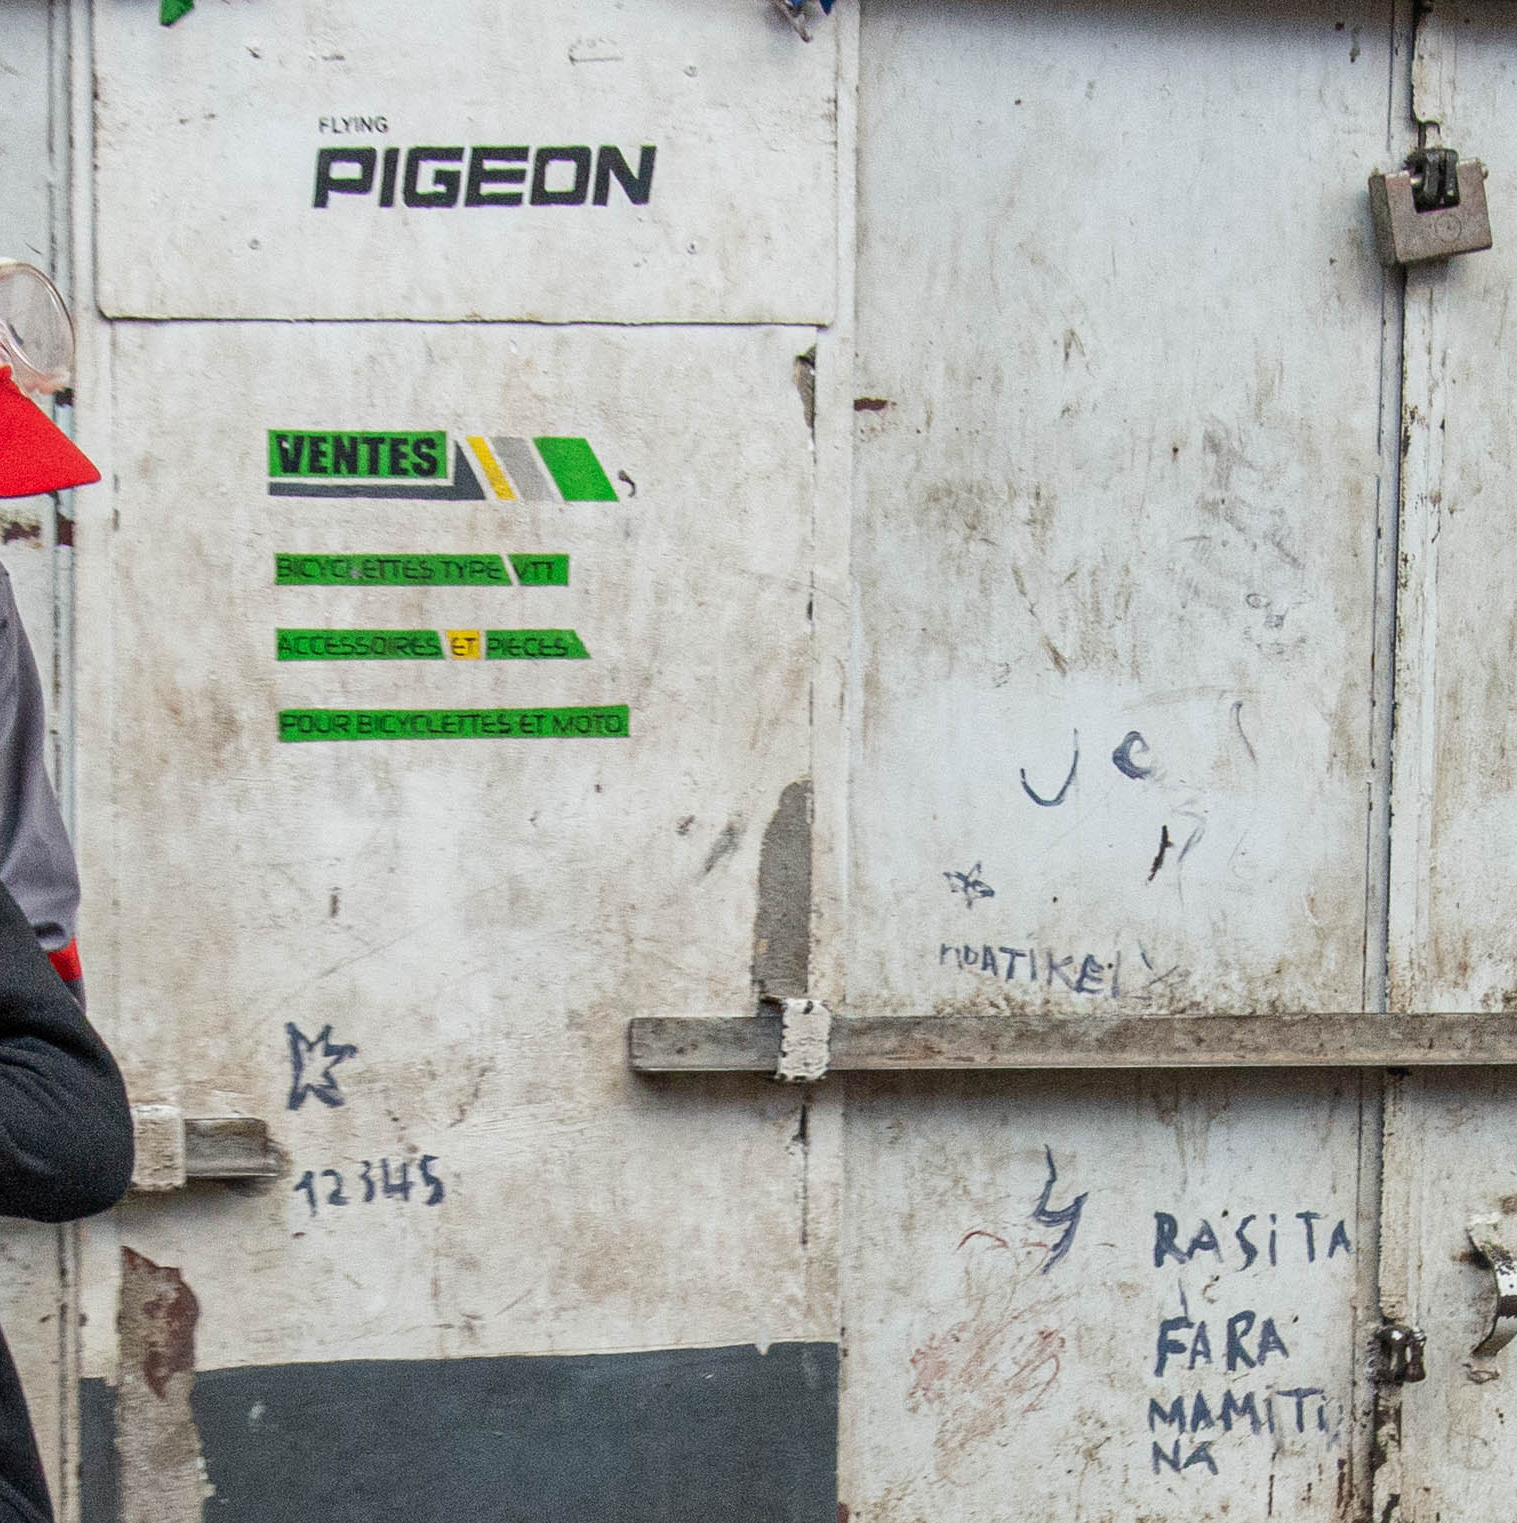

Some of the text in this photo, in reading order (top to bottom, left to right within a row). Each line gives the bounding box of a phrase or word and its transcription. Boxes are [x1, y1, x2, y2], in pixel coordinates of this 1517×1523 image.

[318, 116, 389, 133] FLYING
[313, 145, 657, 208] PIGEON
[275, 435, 438, 476] VENTES
[277, 556, 556, 581] BICYCLETTES TYPE VTT
[279, 635, 568, 657] ACCESSOIRES ET PIECES
[282, 712, 622, 736] POUR BICYCLETTES ET MOTO
[294, 1154, 445, 1217] 12345
[1154, 1309, 1289, 1378] FARA
